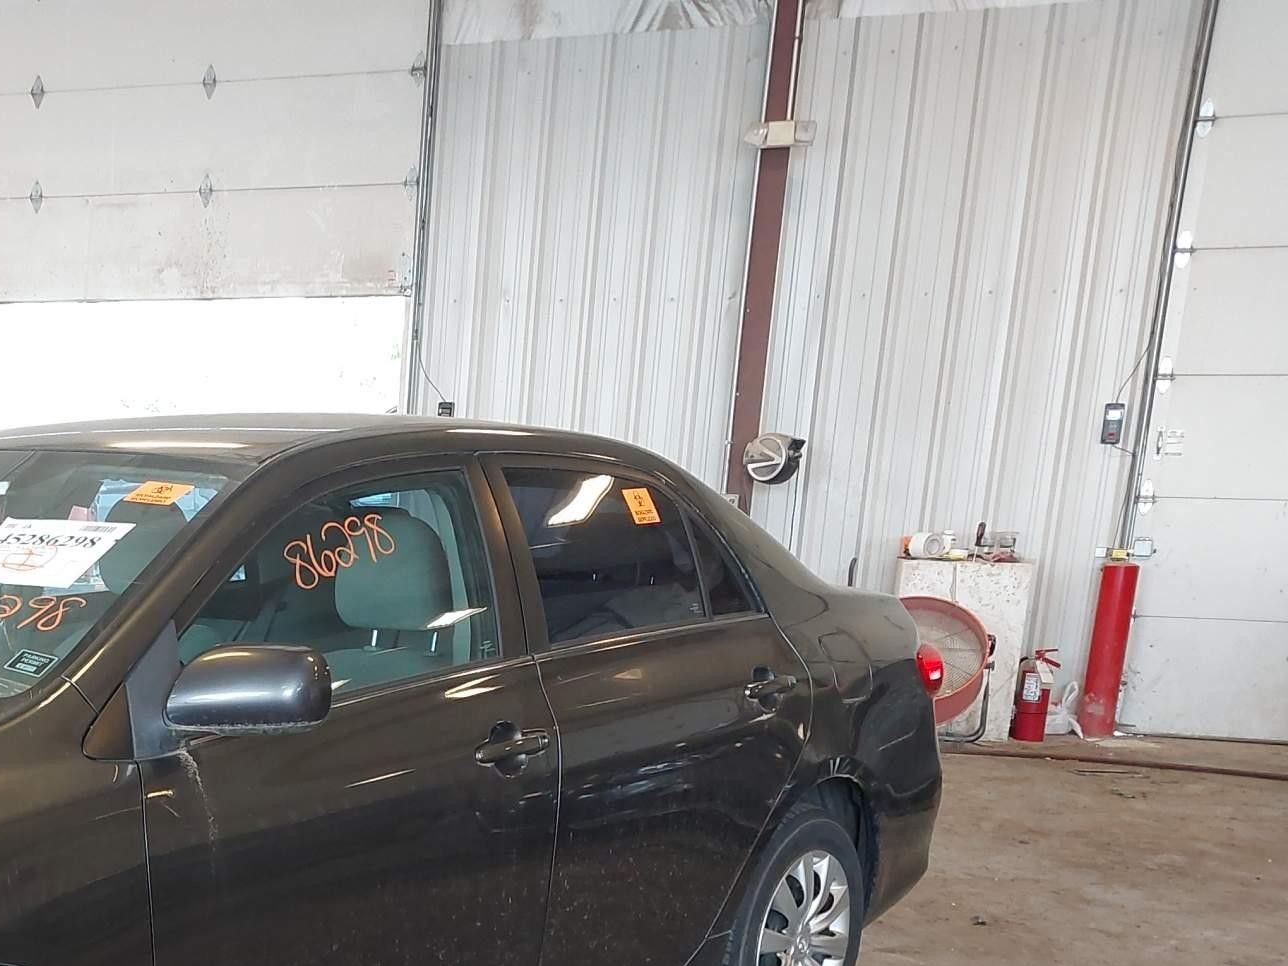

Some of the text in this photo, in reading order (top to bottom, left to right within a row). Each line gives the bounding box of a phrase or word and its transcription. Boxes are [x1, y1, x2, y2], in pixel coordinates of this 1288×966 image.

[283, 513, 396, 590] 86298
[21, 657, 44, 667] PERMIT
[23, 653, 50, 664] PARKING
